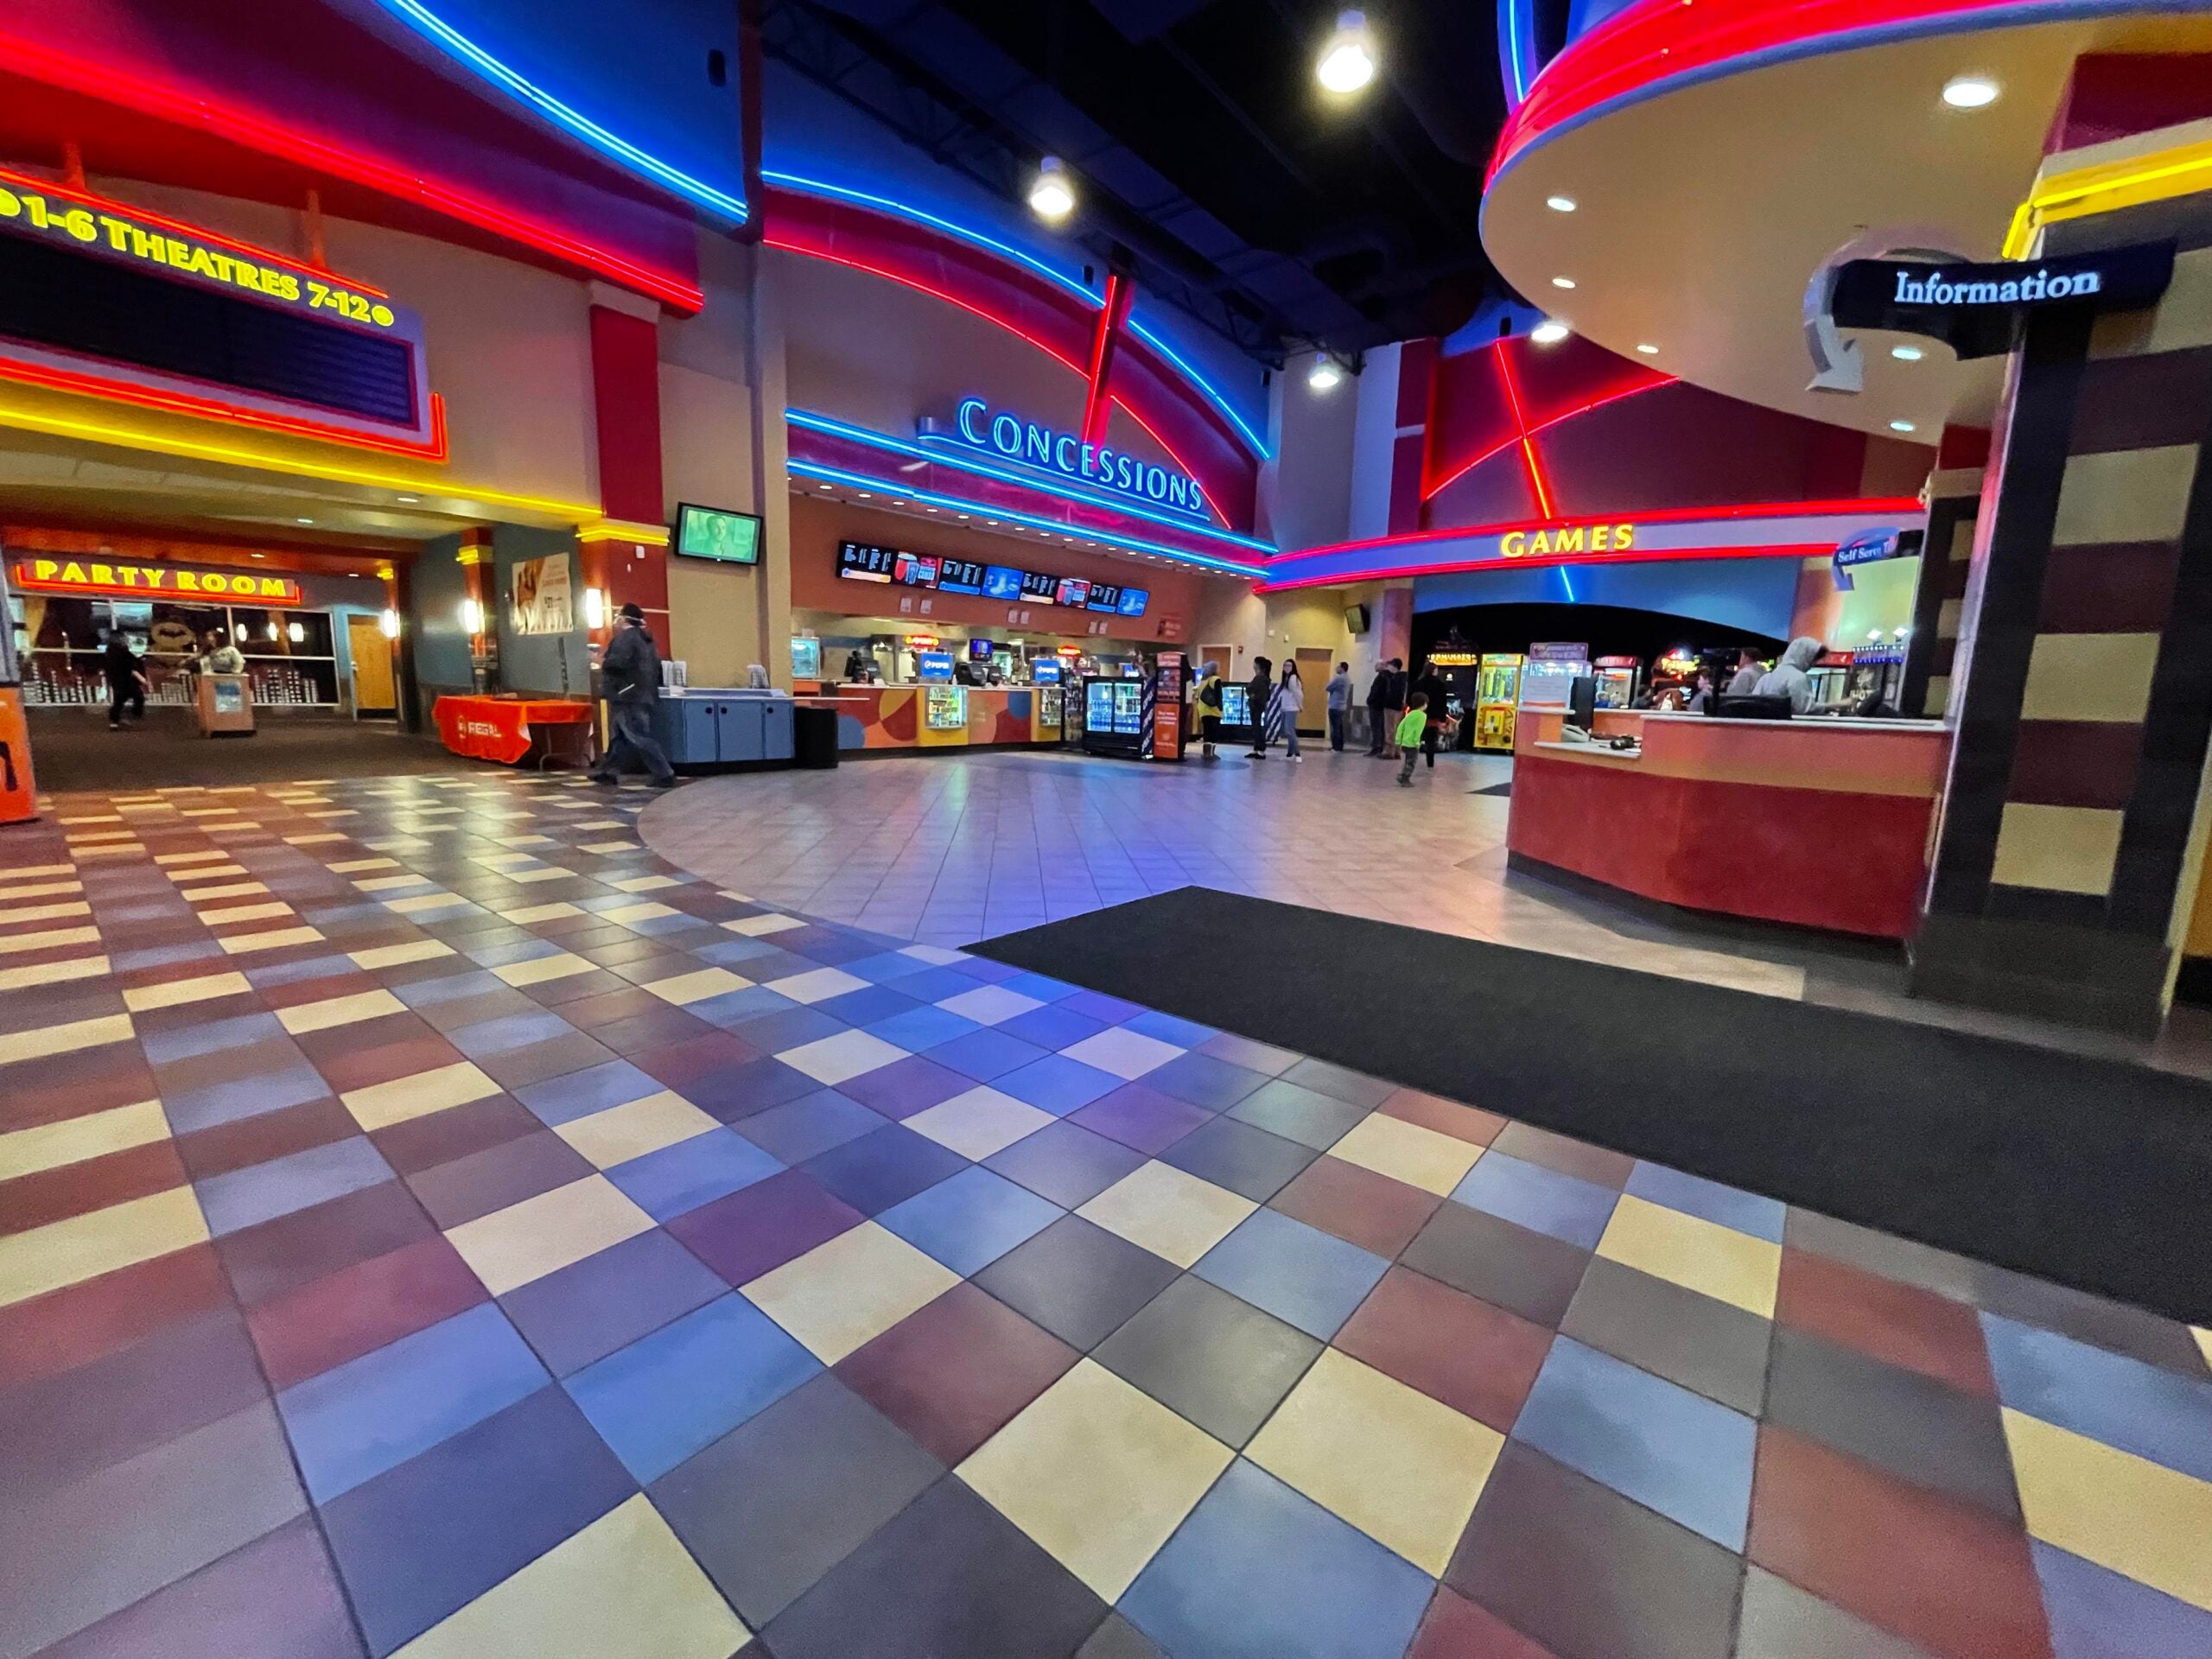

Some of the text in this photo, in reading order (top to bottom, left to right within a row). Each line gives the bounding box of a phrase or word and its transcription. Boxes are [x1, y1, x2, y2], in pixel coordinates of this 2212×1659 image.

[21, 195, 372, 323] 1-6 THEATRES 7-12
[1895, 270, 2101, 305] Information
[959, 400, 1202, 510] CONCESSIONS
[1500, 524, 1633, 558] GAMES
[1838, 549, 1857, 563] Self
[35, 560, 287, 597] PARTY ROOM
